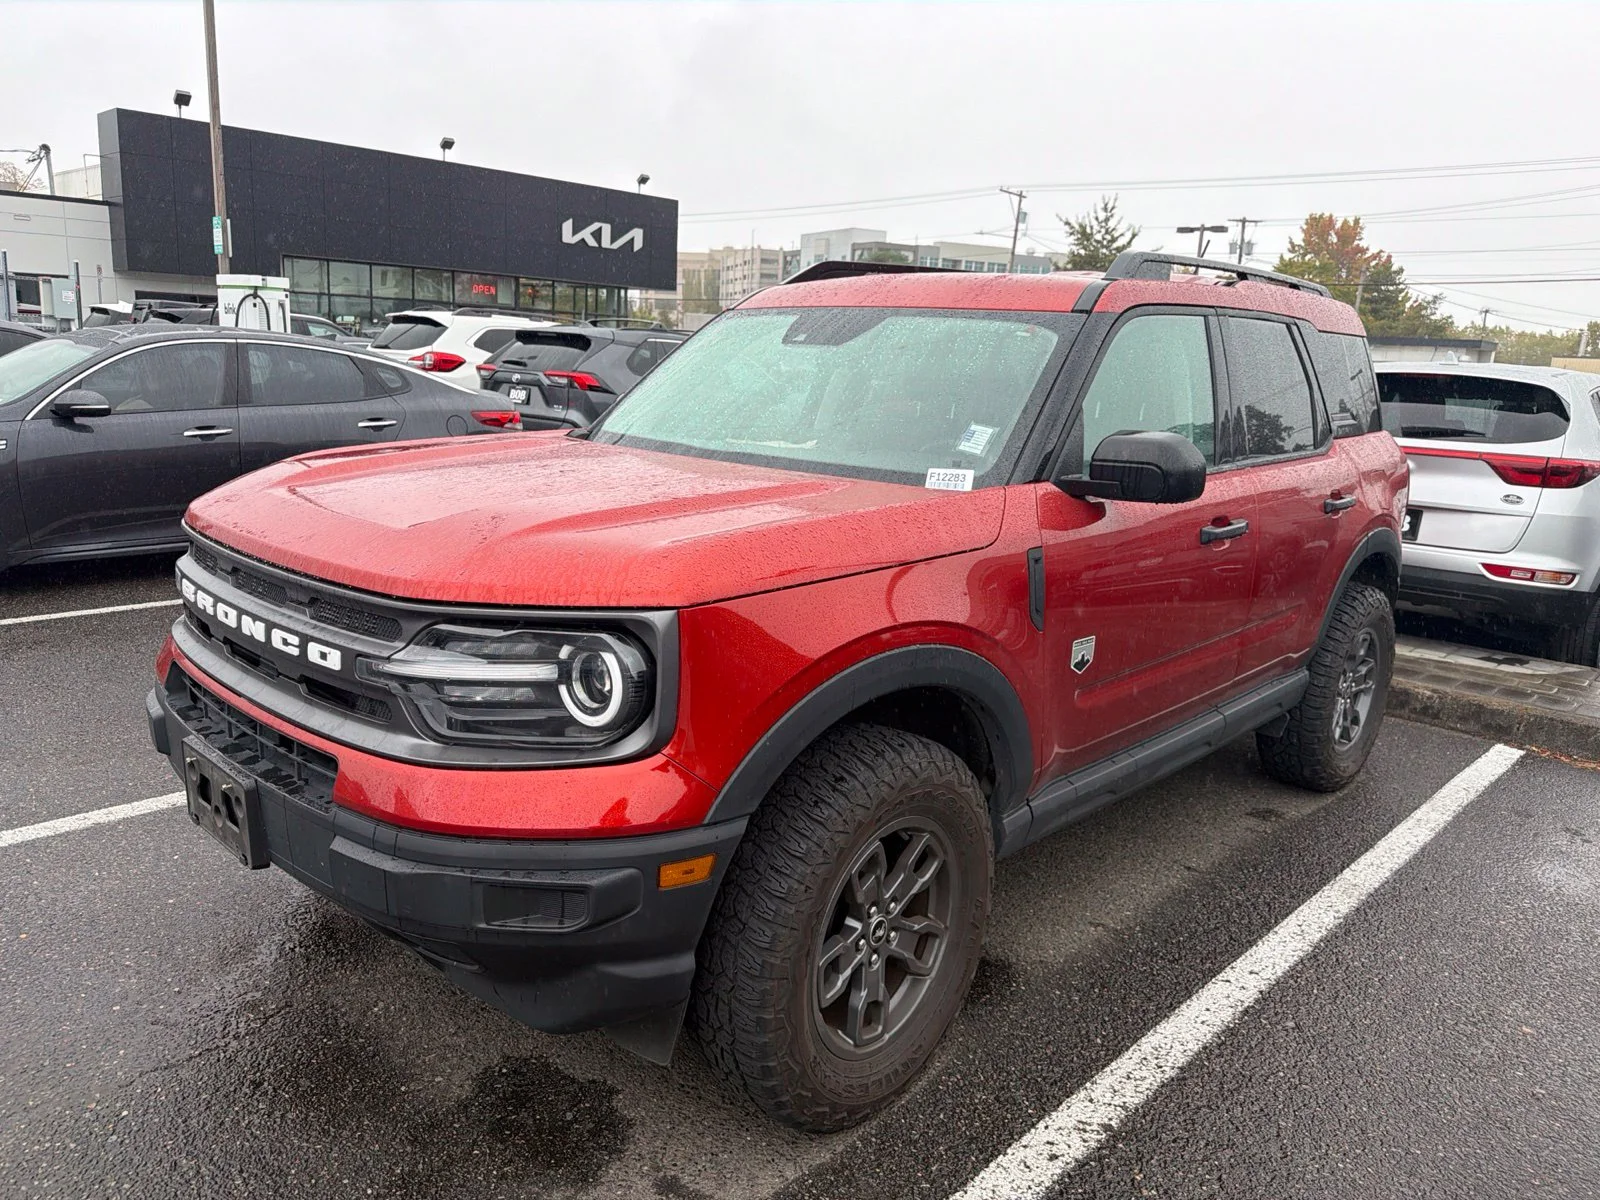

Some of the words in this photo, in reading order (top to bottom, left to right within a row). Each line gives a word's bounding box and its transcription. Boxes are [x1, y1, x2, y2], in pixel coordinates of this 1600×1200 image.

[562, 218, 643, 252] KIA
[472, 283, 496, 295] OPEN
[224, 302, 237, 315] blink
[509, 388, 526, 400] BOB
[929, 472, 967, 482] F12283
[181, 578, 342, 671] BRONCO
